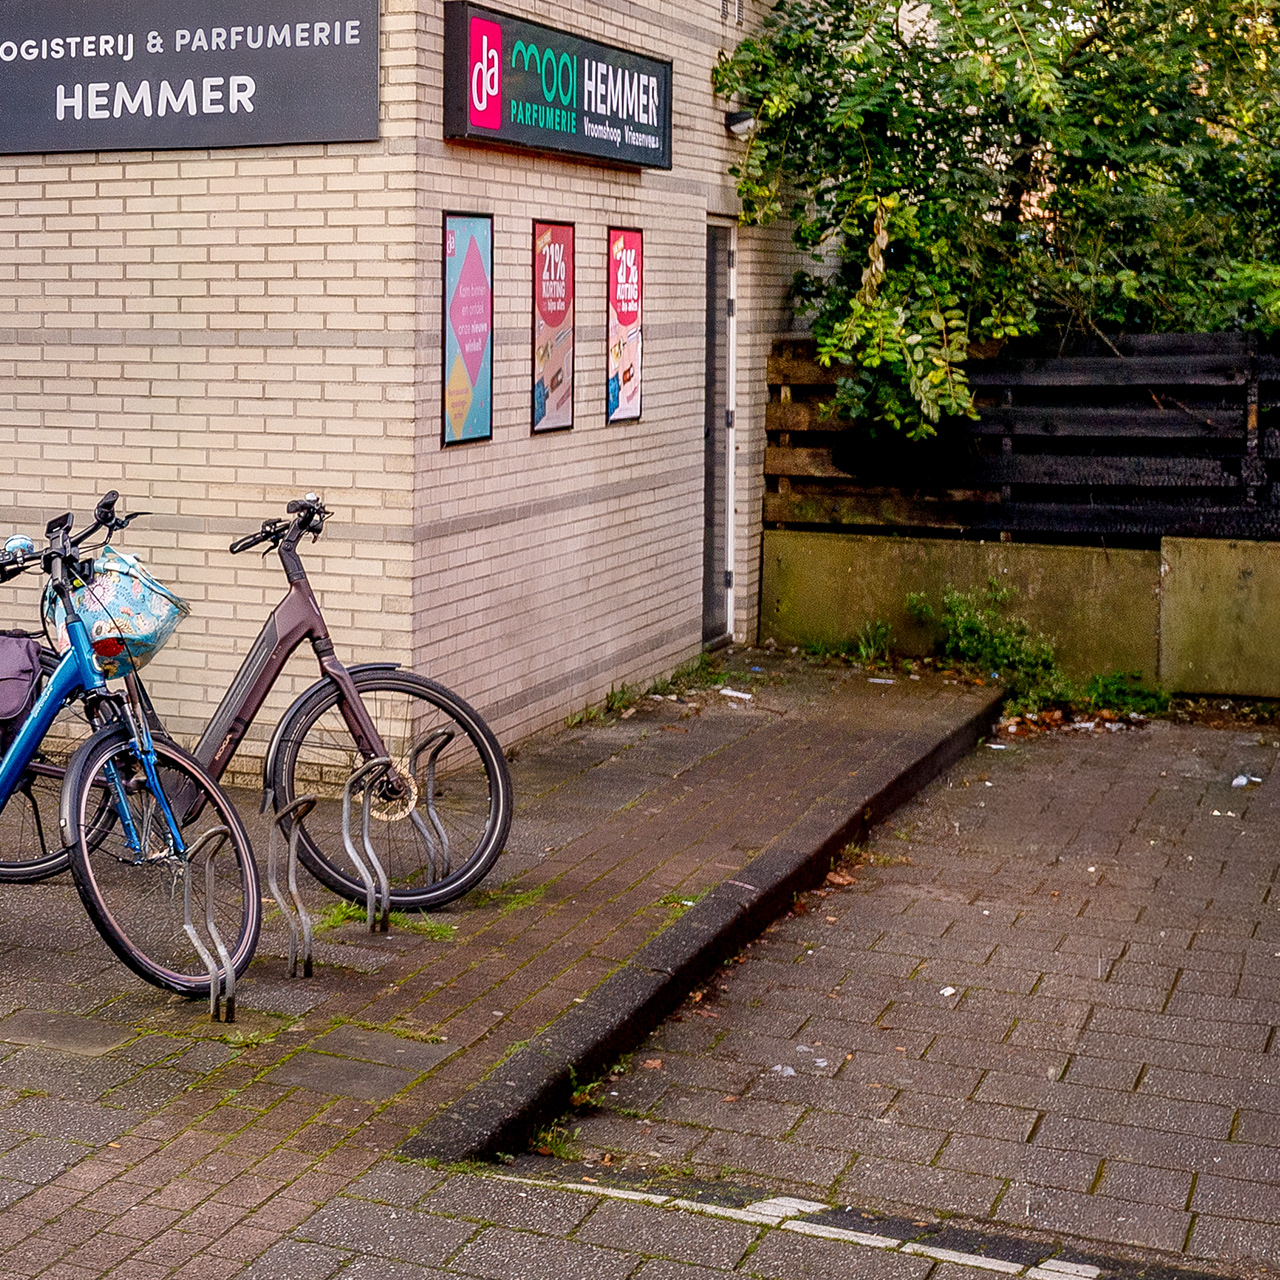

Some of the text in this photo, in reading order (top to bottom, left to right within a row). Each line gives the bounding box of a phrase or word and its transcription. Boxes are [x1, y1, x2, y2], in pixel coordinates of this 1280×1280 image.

[146, 30, 165, 54] &
[174, 19, 362, 53] PARFUMERIE
[471, 35, 499, 112] da
[583, 58, 659, 128] HEMMER
[55, 75, 257, 121] HEMMER
[510, 99, 577, 134] PARFUMERIE
[583, 115, 622, 148] Vroomshoop
[541, 242, 566, 281] 21%
